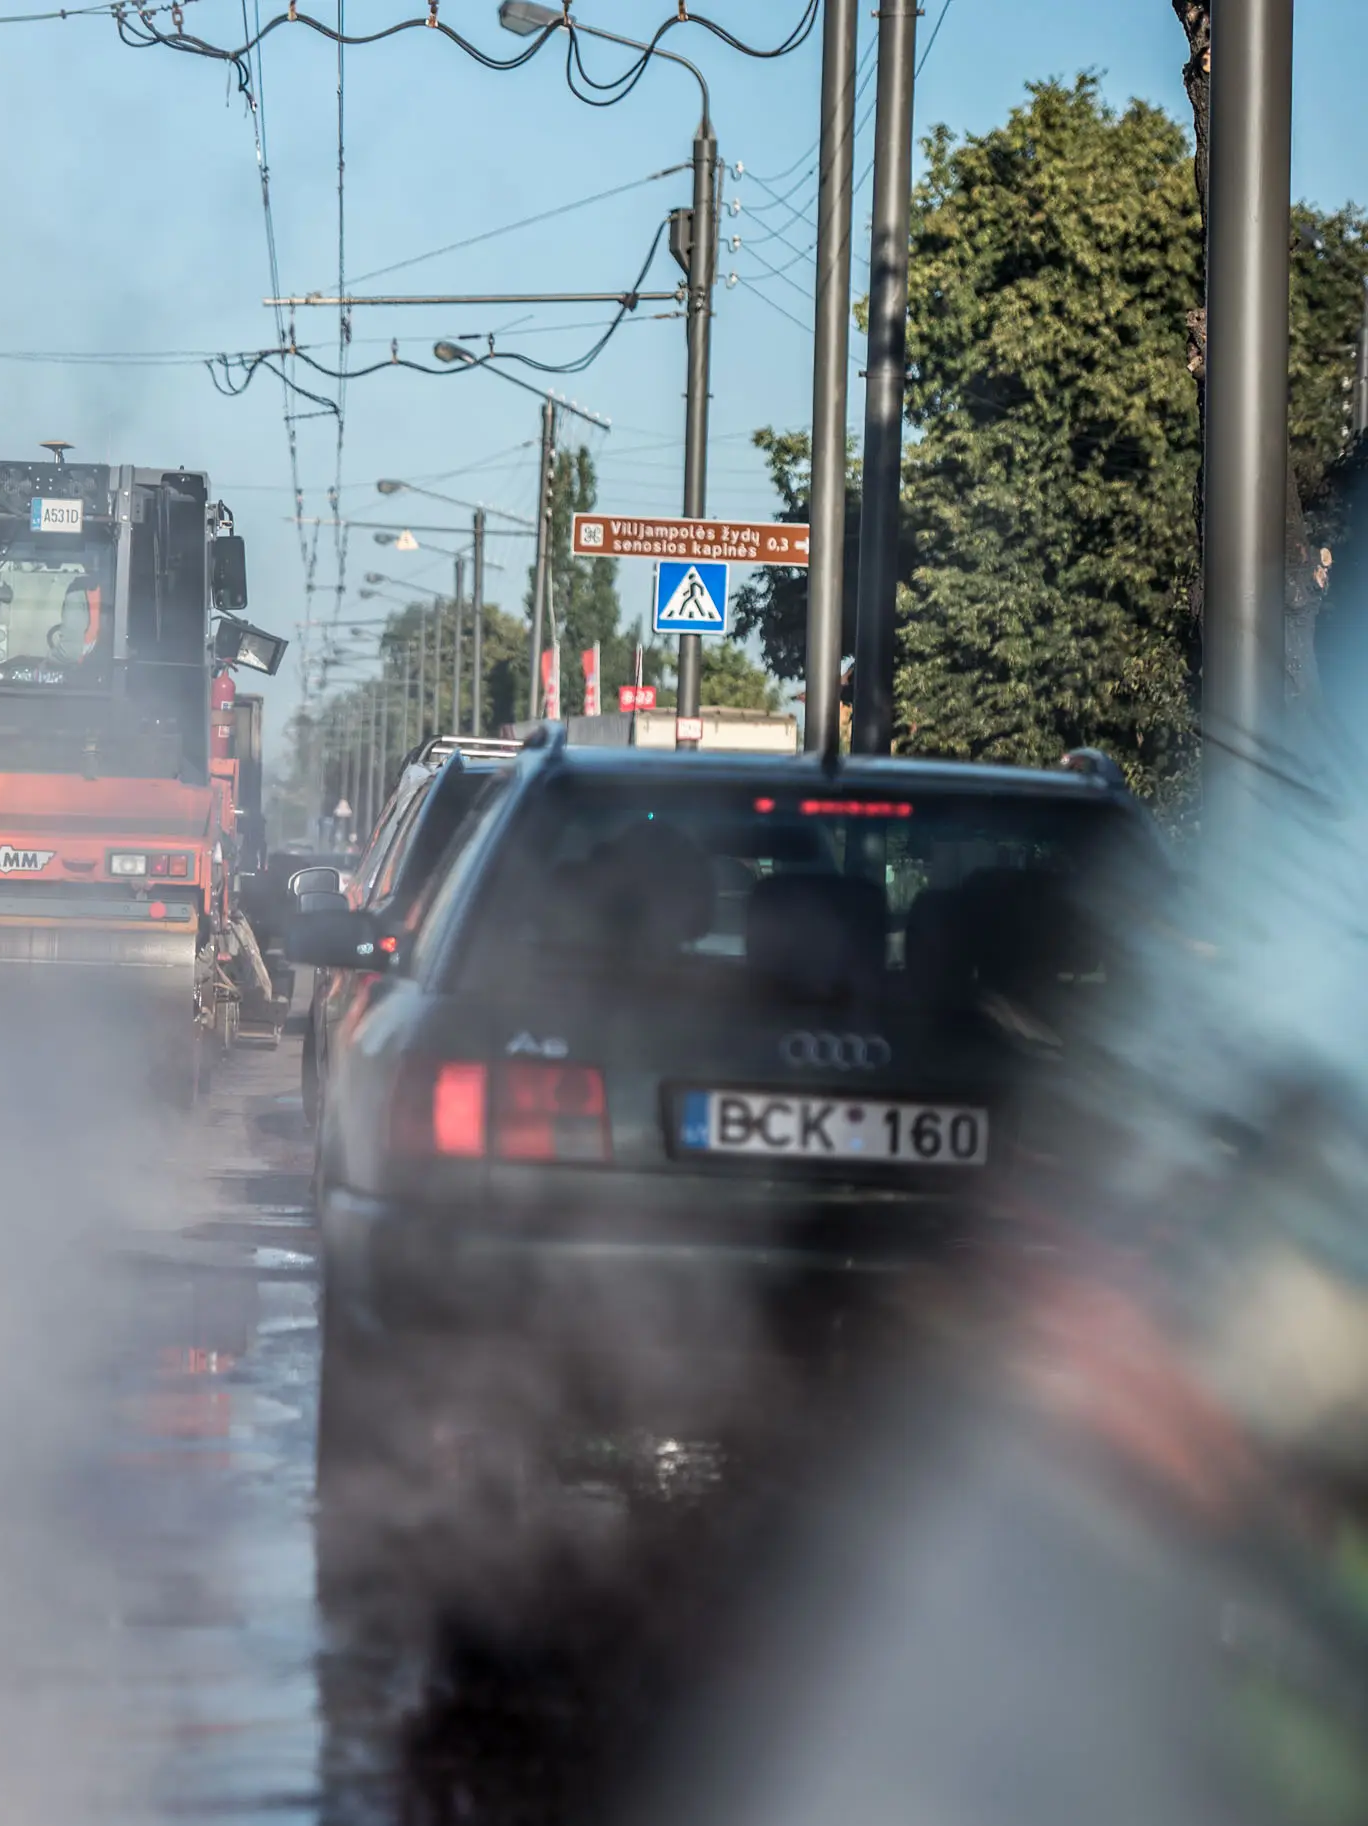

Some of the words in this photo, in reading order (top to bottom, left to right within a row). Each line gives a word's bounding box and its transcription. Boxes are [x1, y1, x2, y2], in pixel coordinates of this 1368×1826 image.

[610, 519, 716, 541] Vilijampolės
[721, 525, 761, 547] žydų
[612, 538, 687, 554] senosios
[692, 540, 758, 560] kapinės
[718, 1097, 837, 1153] BCK
[884, 1107, 981, 1161] 160
